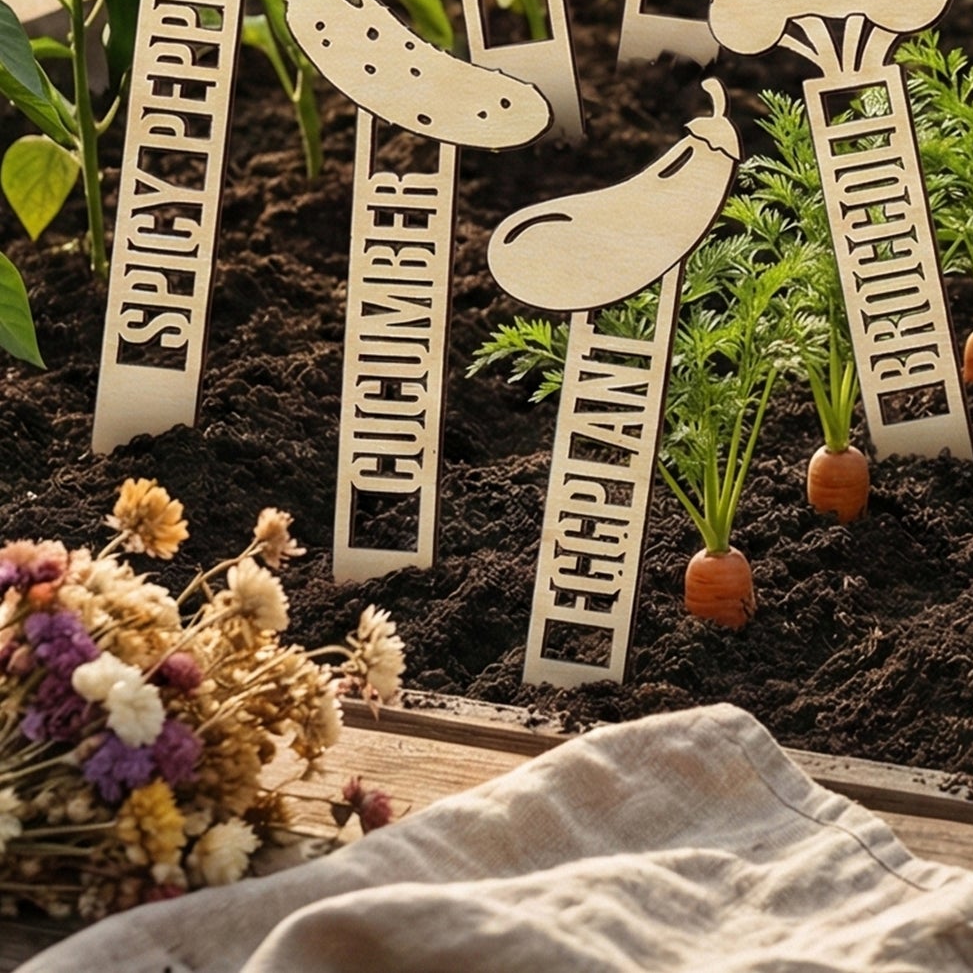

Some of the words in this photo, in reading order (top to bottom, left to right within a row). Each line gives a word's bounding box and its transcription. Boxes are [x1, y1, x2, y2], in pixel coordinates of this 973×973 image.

[118, 167, 205, 348] SPICY
[351, 172, 440, 492] CUCUMBER
[826, 114, 943, 392] BROCCOLI
[545, 324, 656, 627] EGGPLANT
